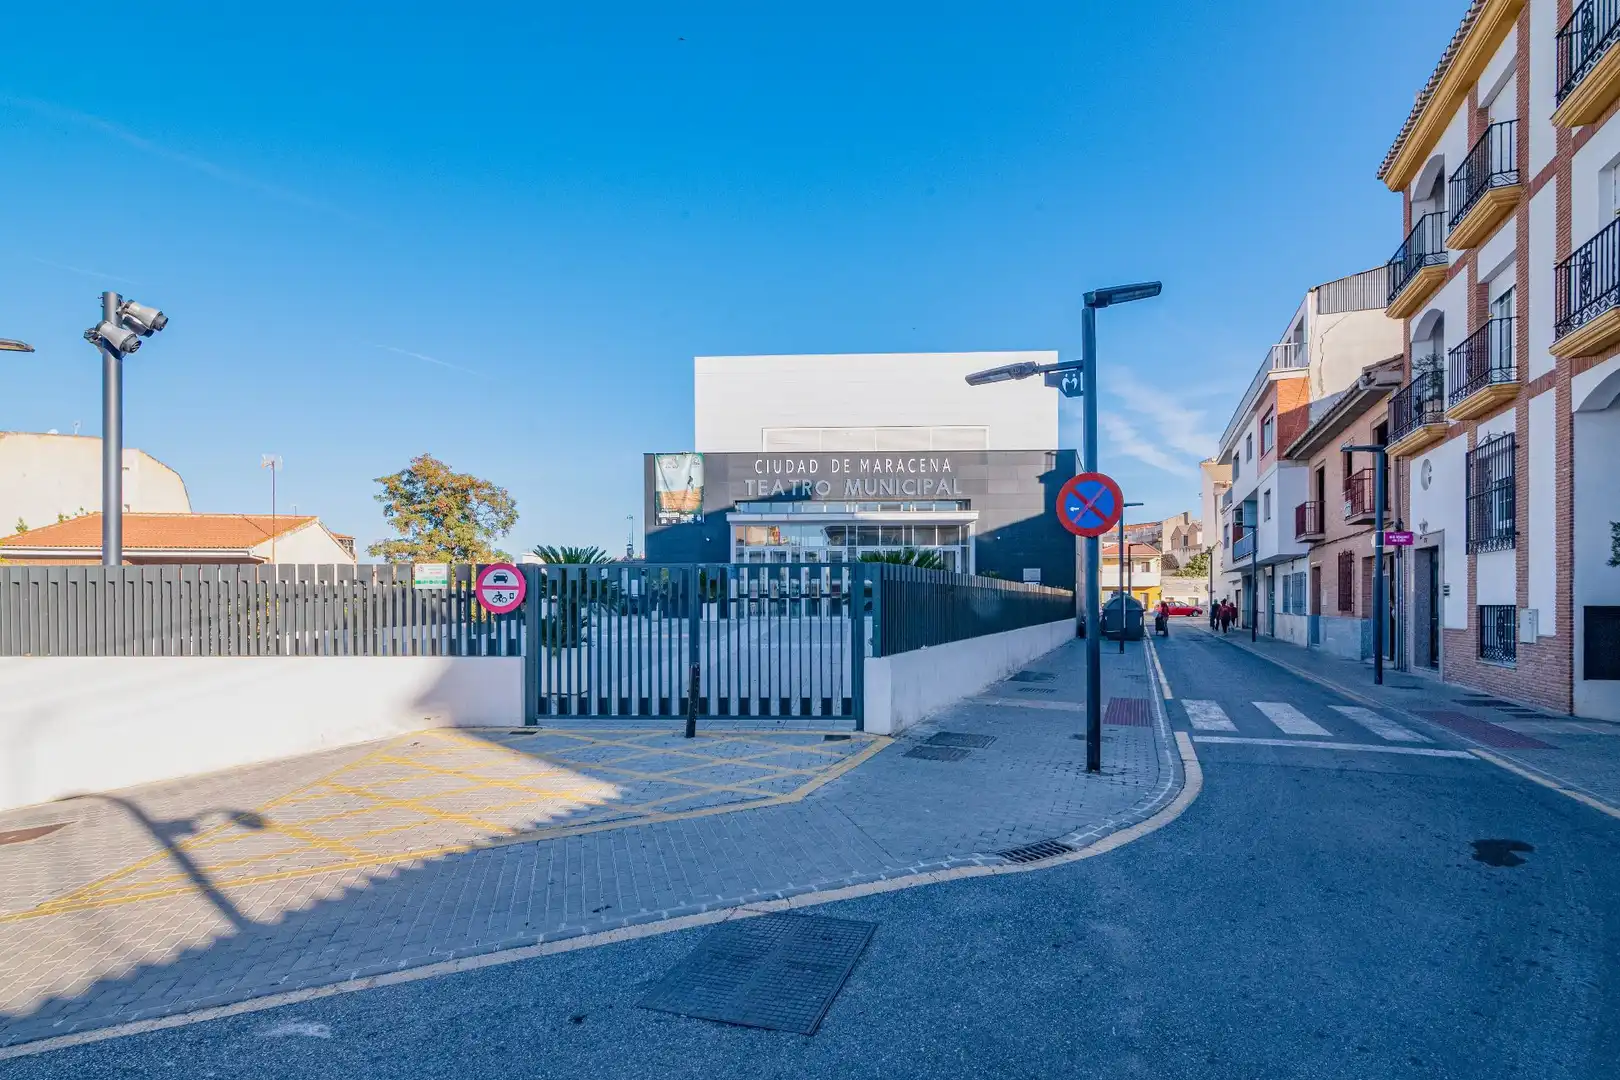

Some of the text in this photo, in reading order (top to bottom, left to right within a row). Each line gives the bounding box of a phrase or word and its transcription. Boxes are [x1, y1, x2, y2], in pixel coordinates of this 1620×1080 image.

[754, 458, 953, 474] CIUDAD DE MARACENA
[744, 477, 963, 496] TEATRO MUNICIPAL
